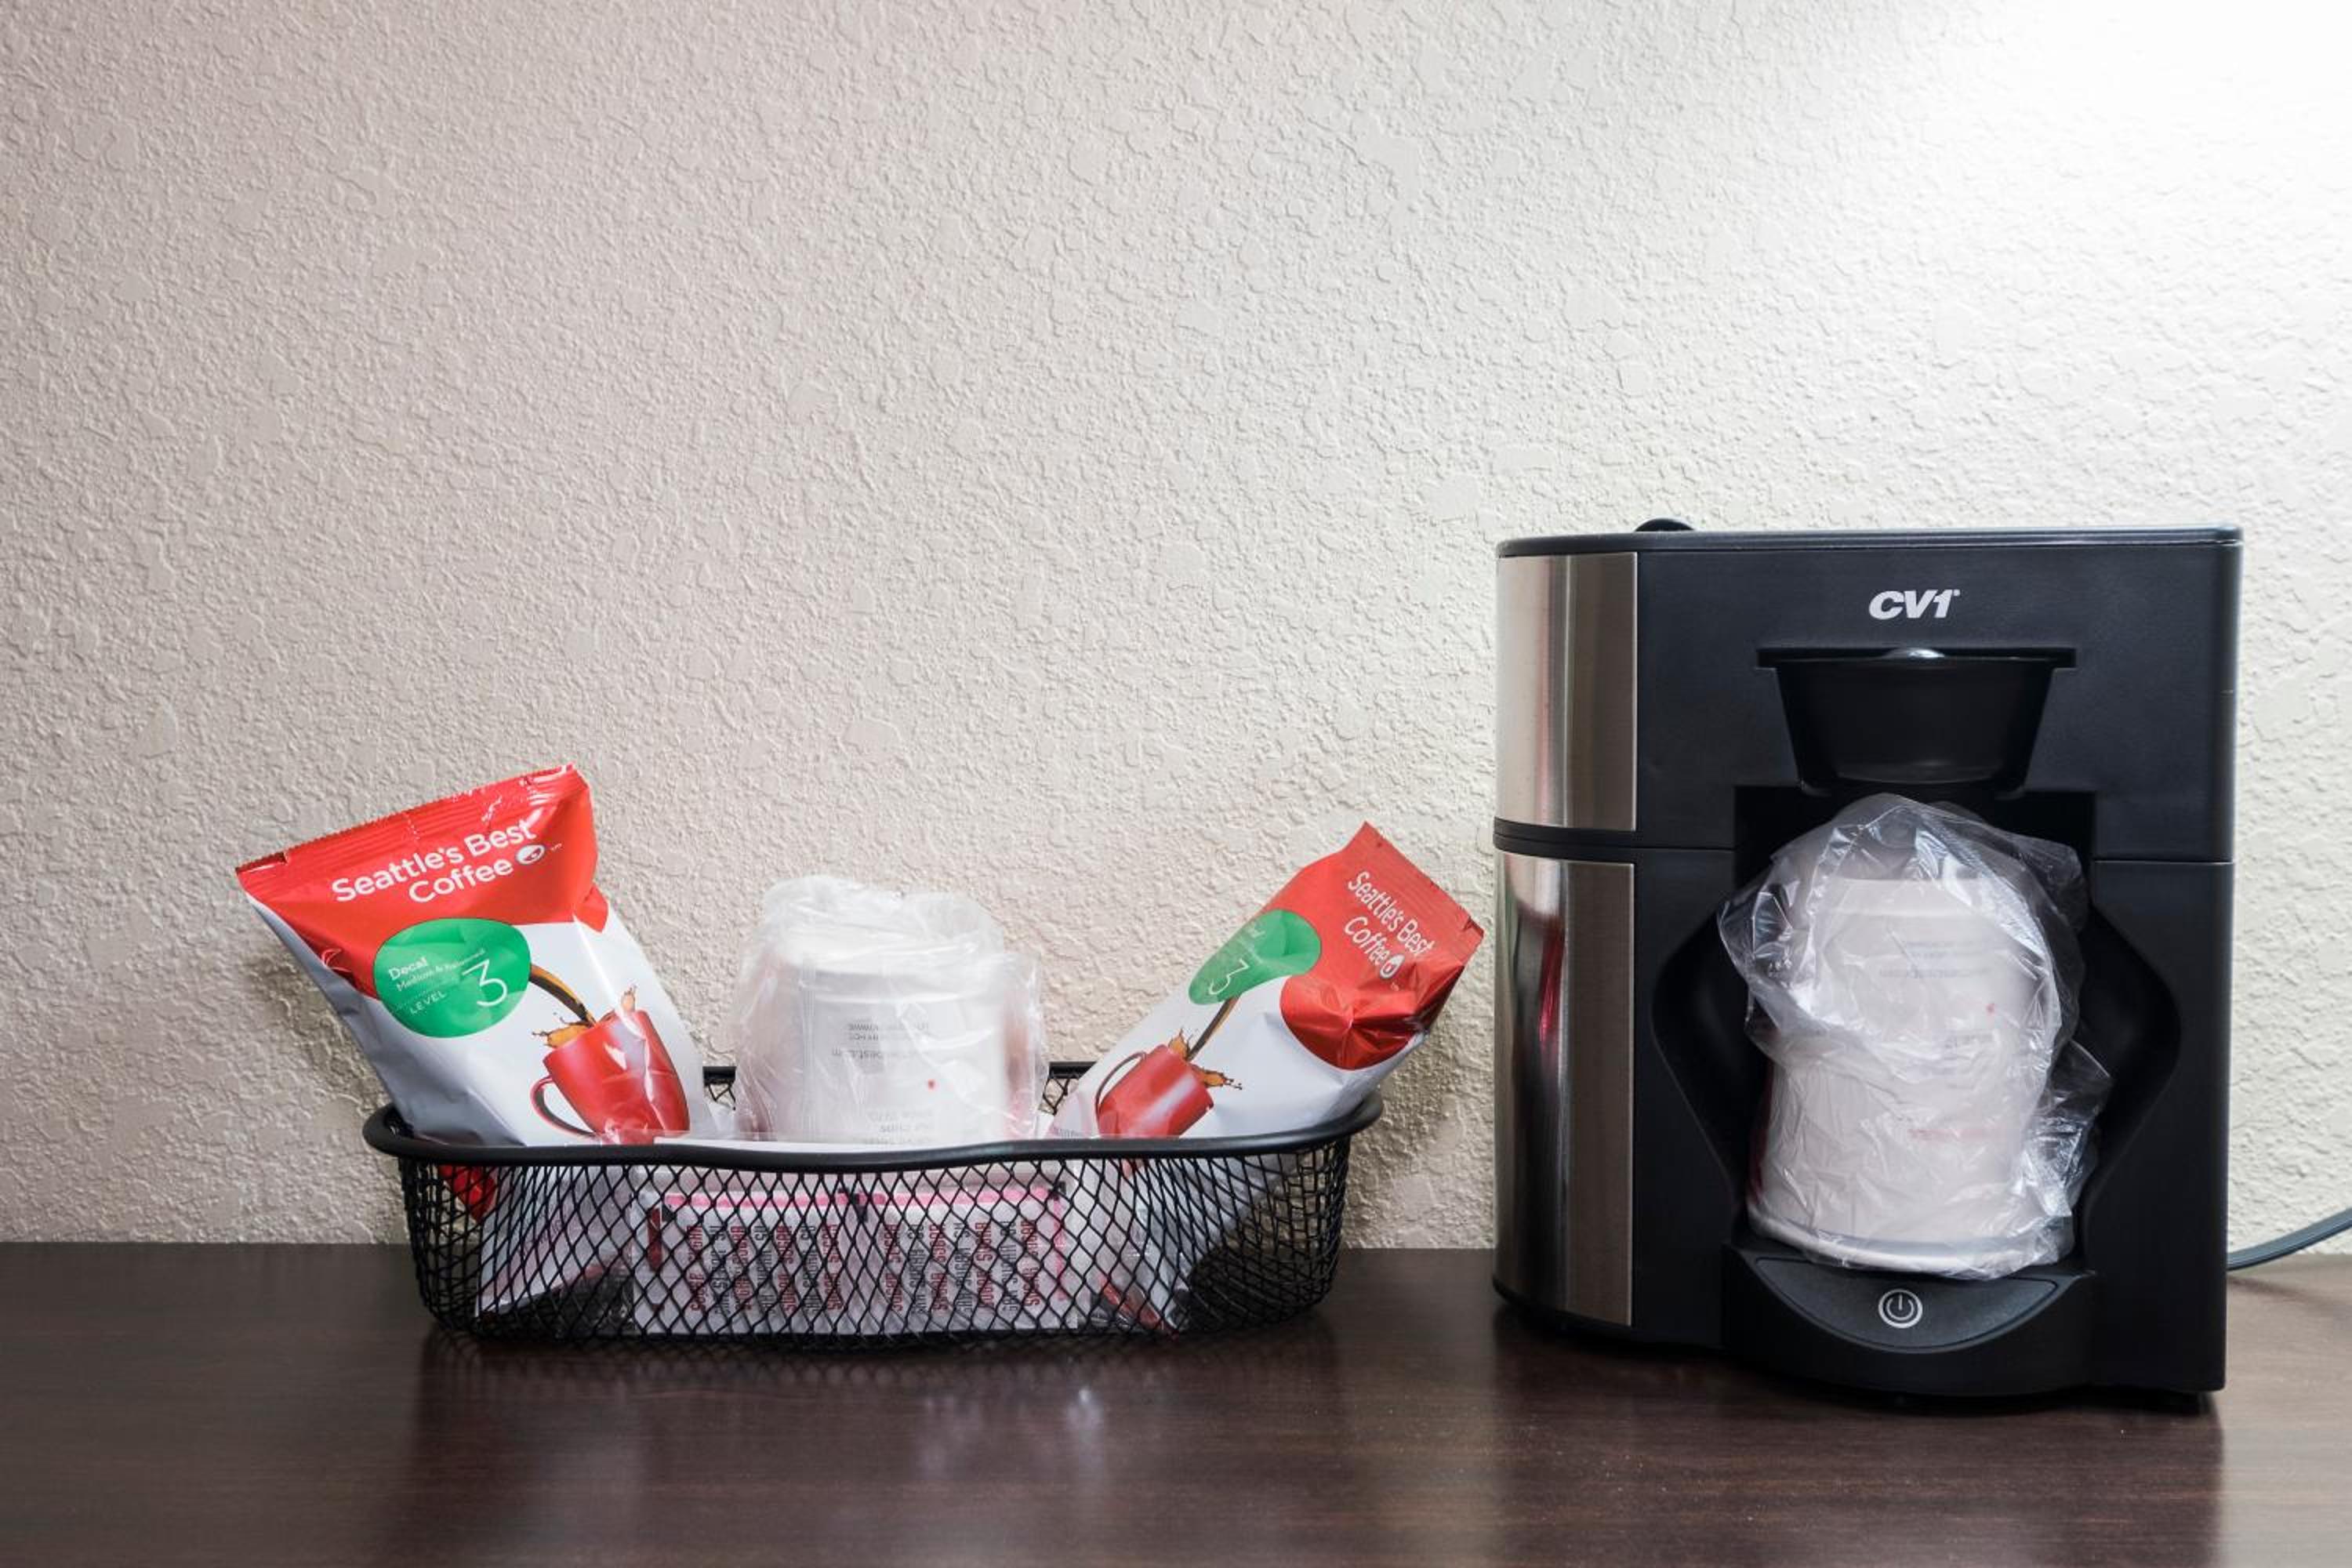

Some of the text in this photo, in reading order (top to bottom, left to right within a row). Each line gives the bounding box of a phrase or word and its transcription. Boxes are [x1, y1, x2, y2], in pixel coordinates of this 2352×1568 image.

[1868, 589, 1954, 620] CV1
[332, 818, 538, 902] Seattle's Best
[408, 858, 514, 902] Coffee
[1347, 870, 1436, 956] Seattle's Best
[1344, 916, 1391, 965] Coffee
[461, 958, 508, 1007] 3
[1208, 958, 1250, 995] 3
[408, 989, 447, 1015] LEVEL
